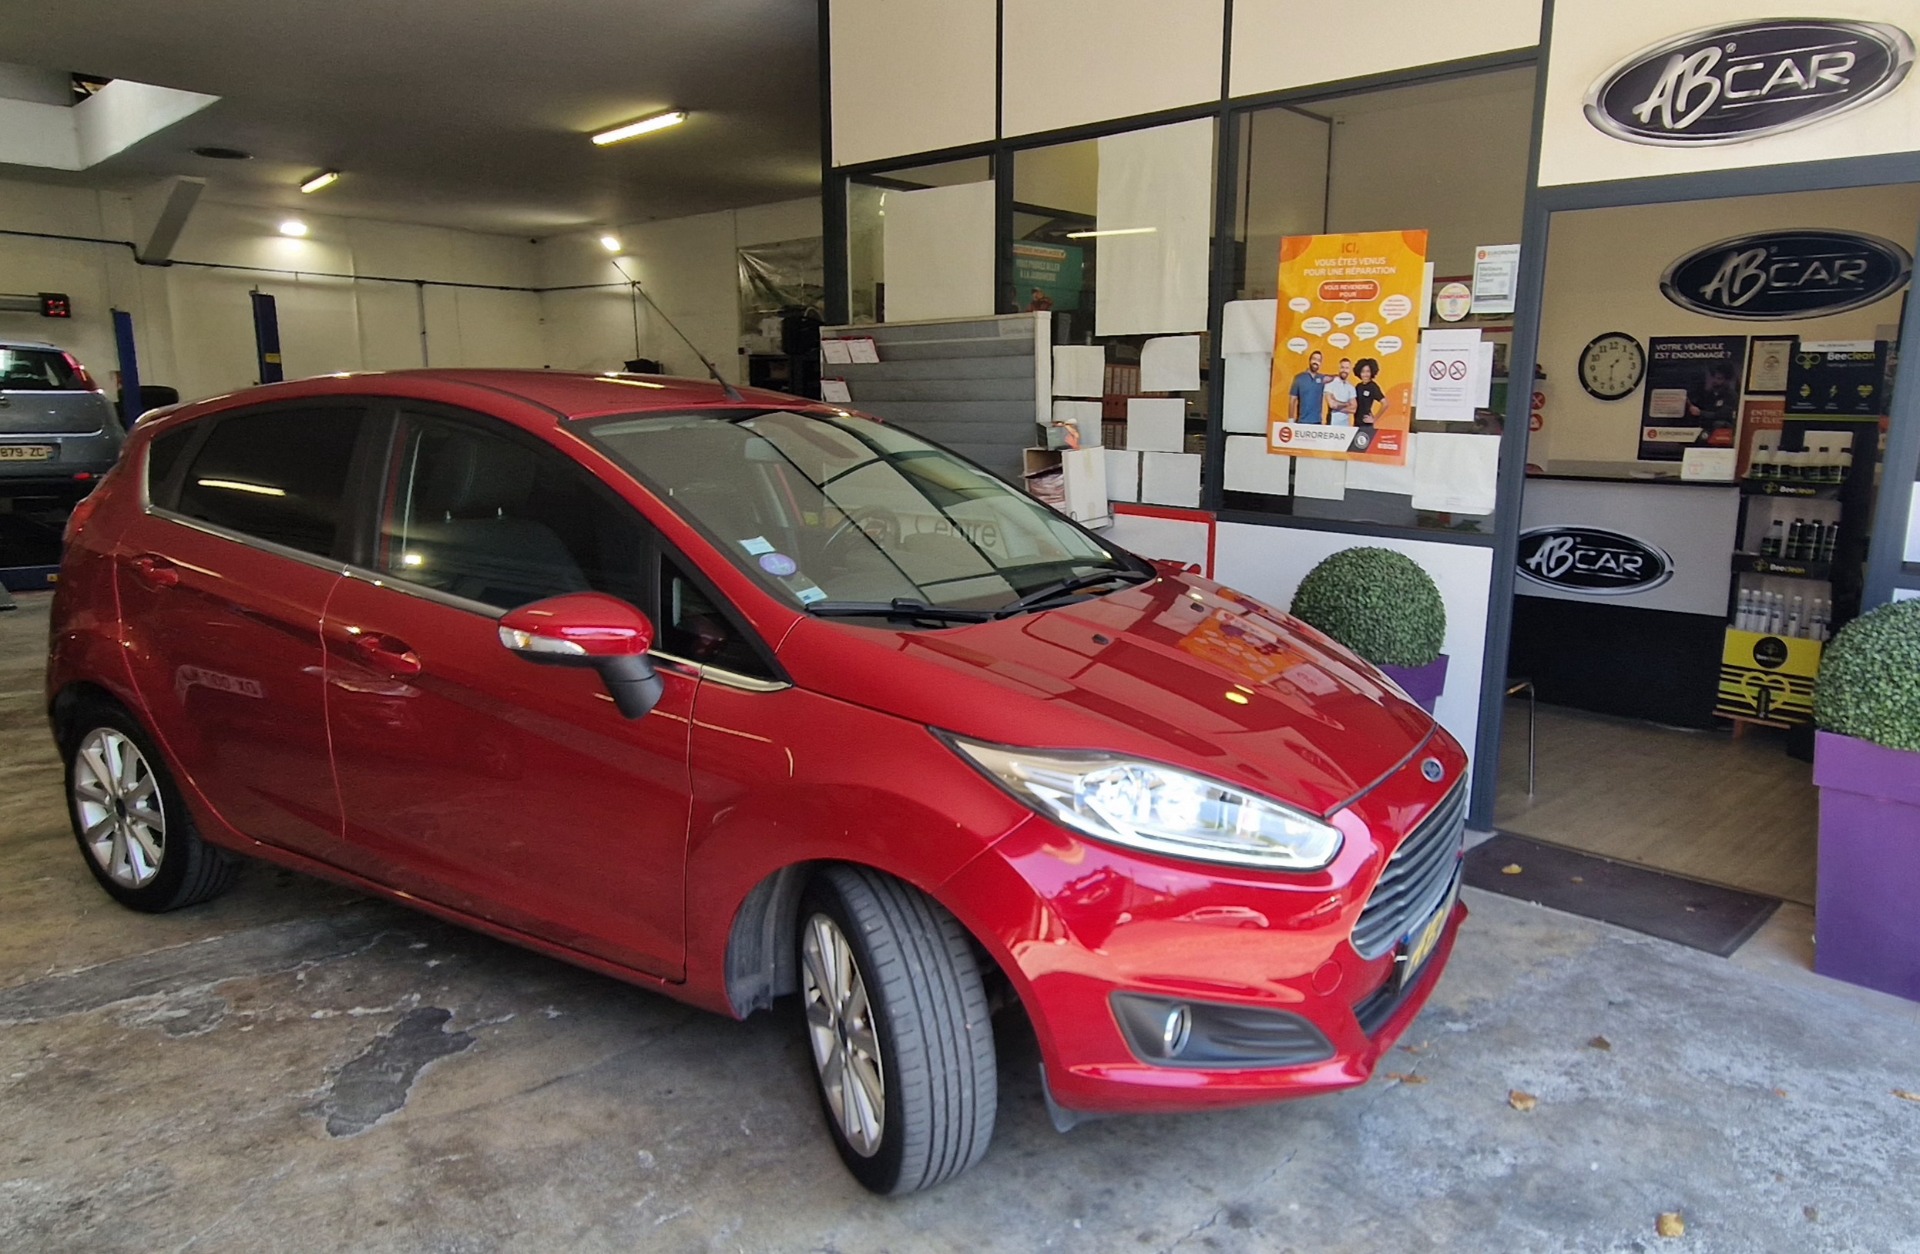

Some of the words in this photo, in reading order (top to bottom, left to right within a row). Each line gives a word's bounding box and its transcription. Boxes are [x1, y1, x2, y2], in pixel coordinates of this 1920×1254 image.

[1315, 259, 1336, 267] VOUS
[1359, 257, 1386, 265] VENUS
[1345, 266, 1396, 275] RÉPARATION
[1684, 342, 1724, 350] VÉHICULE
[1671, 351, 1724, 359] ENDOMMAGÉ
[1827, 352, 1876, 360] Beeclean
[1295, 430, 1346, 440] EUROREPAR
[1780, 486, 1816, 495] Beeclean
[1770, 563, 1806, 574] Beeclean
